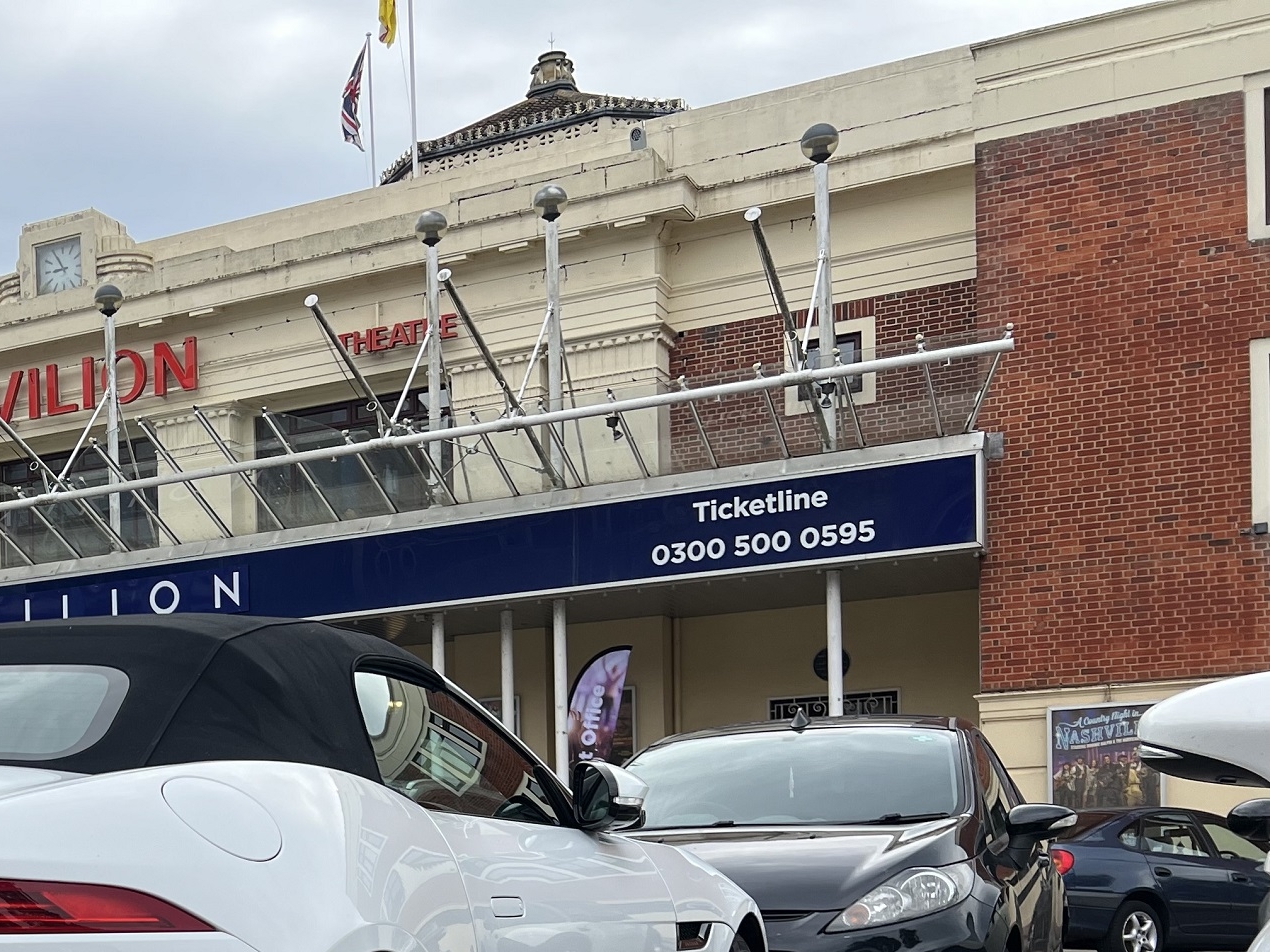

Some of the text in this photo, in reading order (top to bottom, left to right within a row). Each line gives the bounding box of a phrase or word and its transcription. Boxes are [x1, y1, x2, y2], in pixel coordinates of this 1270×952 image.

[338, 313, 458, 355] THEATE
[693, 489, 829, 522] Ticketline
[651, 519, 876, 566] 0300 500 0595
[580, 684, 606, 747] Office
